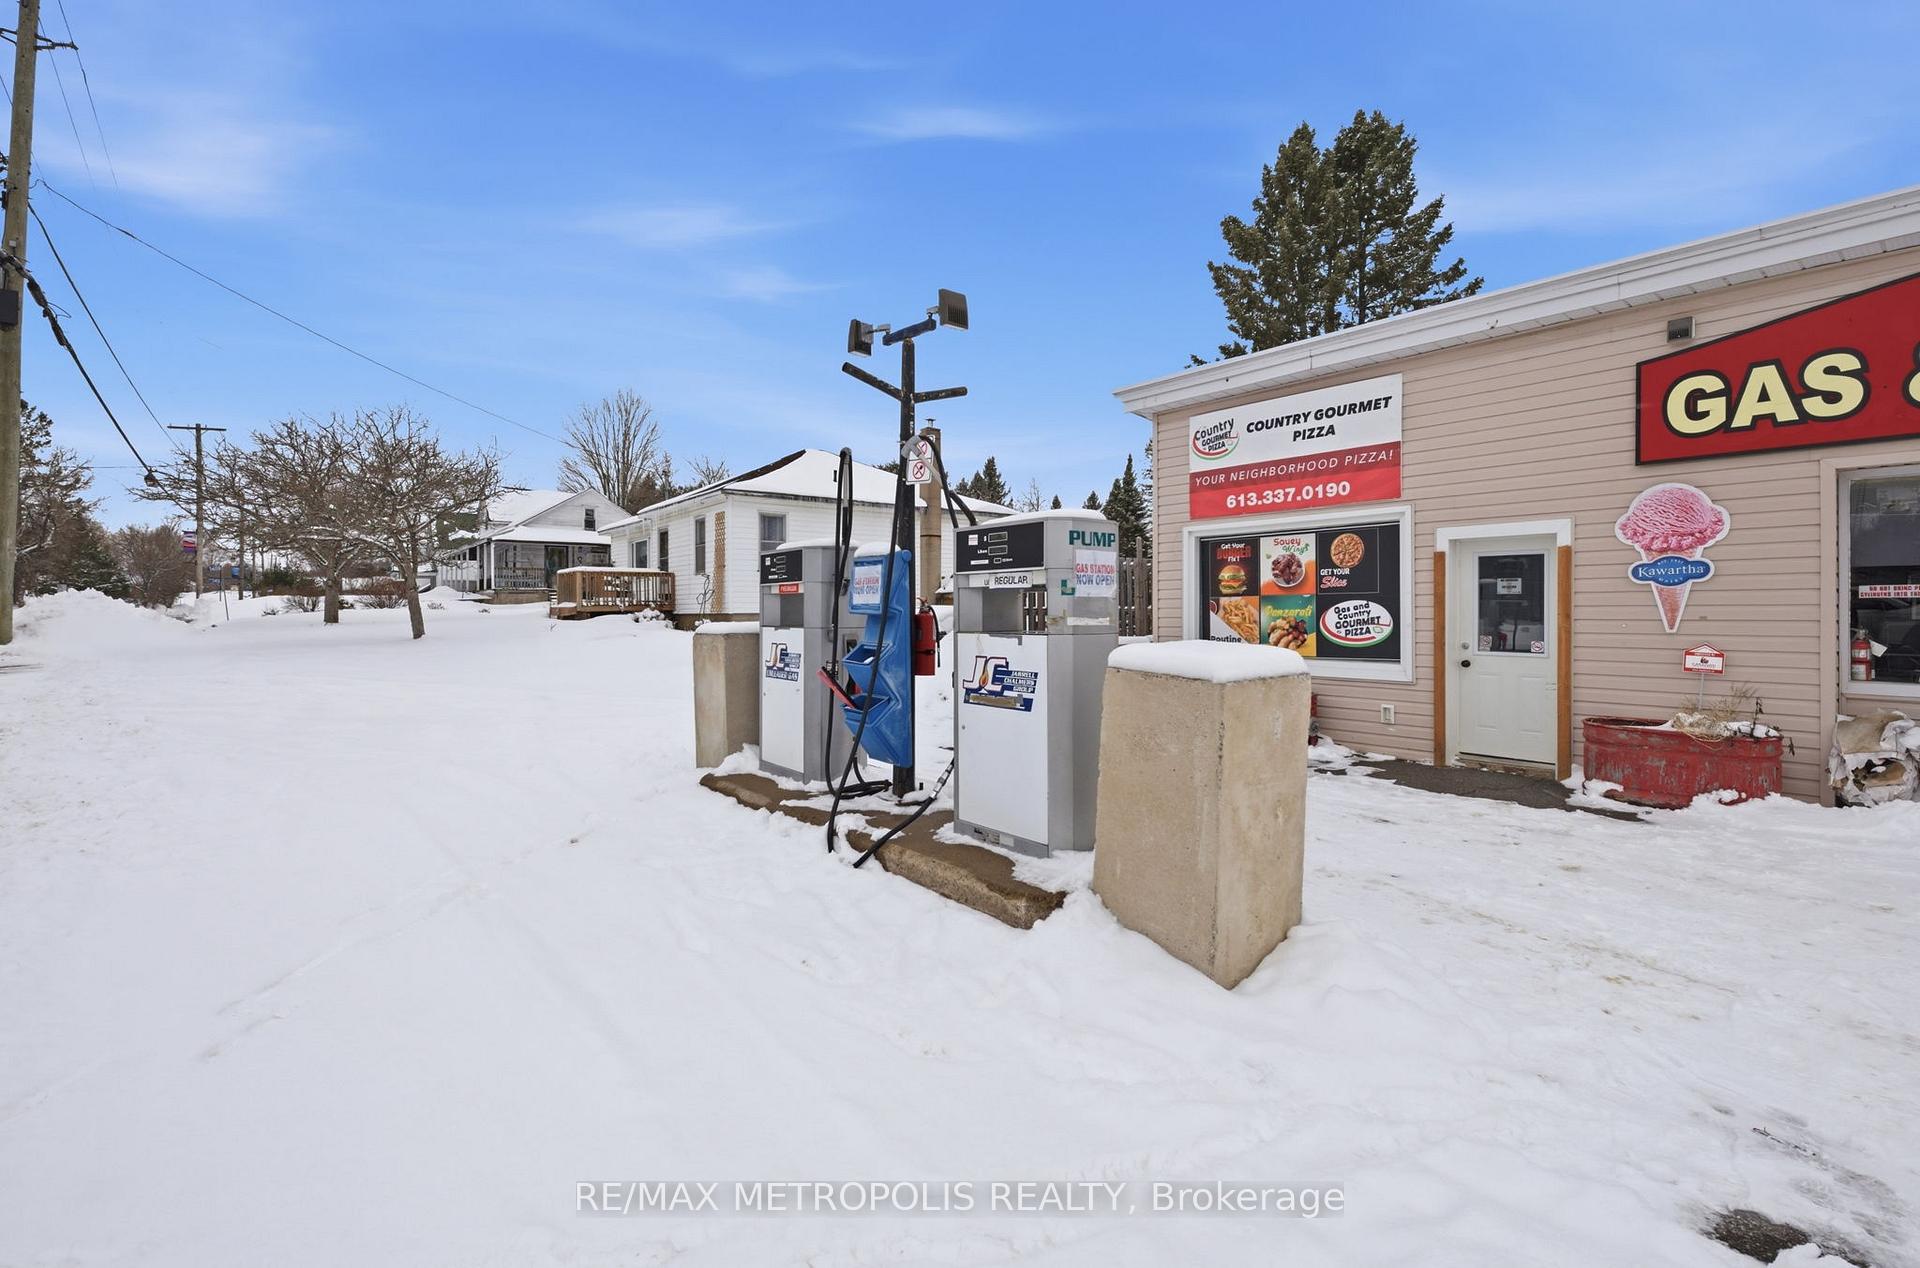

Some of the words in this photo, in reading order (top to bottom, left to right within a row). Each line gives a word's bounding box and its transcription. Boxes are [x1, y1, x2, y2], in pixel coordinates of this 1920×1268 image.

[1665, 350, 1868, 436] GAS
[1246, 411, 1311, 433] COUNTRY
[1314, 396, 1392, 421] GOURMET
[1195, 418, 1234, 440] Country
[1293, 424, 1336, 441] PIZZA
[1201, 431, 1232, 446] GOURMET
[1208, 441, 1226, 452] PIZZA
[1195, 474, 1225, 486] YOUR
[1230, 458, 1338, 481] NEIGHBORHOOD
[1344, 450, 1393, 466] PIZZA!
[1226, 481, 1350, 508] 613.337.0190
[1068, 530, 1116, 547] PUMP
[1076, 564, 1089, 573] GAS
[1090, 564, 1115, 574] STATION
[1638, 565, 1704, 577] Kawartha
[994, 576, 1028, 585] REGULAR
[1076, 574, 1093, 585] NOW
[1095, 574, 1114, 585] OPEN
[1334, 606, 1351, 614] Gas
[1353, 601, 1370, 610] and
[1337, 610, 1371, 620] Country
[1335, 616, 1381, 629] GOURMET
[1345, 626, 1371, 637] PIZZA
[1210, 635, 1242, 643] Poutine
